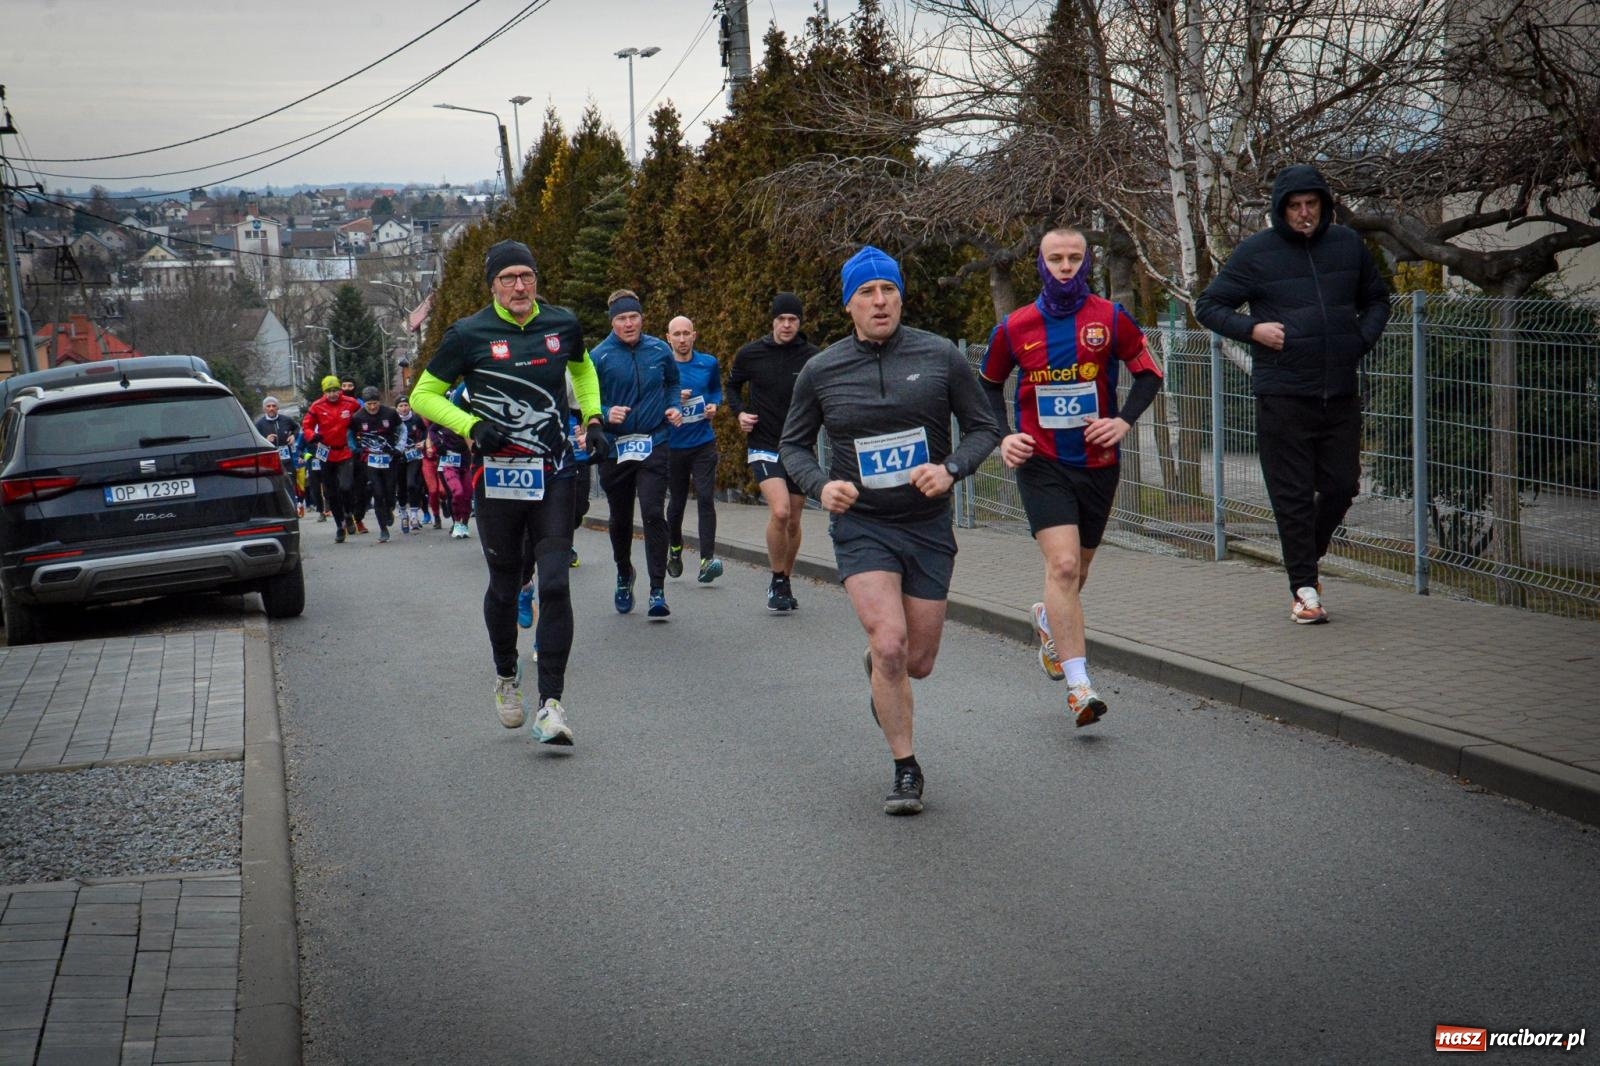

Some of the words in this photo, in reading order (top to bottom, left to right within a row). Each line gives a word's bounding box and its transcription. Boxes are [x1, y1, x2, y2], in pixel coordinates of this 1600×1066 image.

[1029, 363, 1078, 382] unicef
[683, 405, 697, 417] 37
[1054, 396, 1081, 415] 86
[623, 441, 645, 452] 150
[871, 444, 916, 473] 147
[496, 469, 534, 487] 120
[115, 486, 136, 501] OP
[143, 480, 190, 497] 1239P
[134, 512, 176, 522] Ateca
